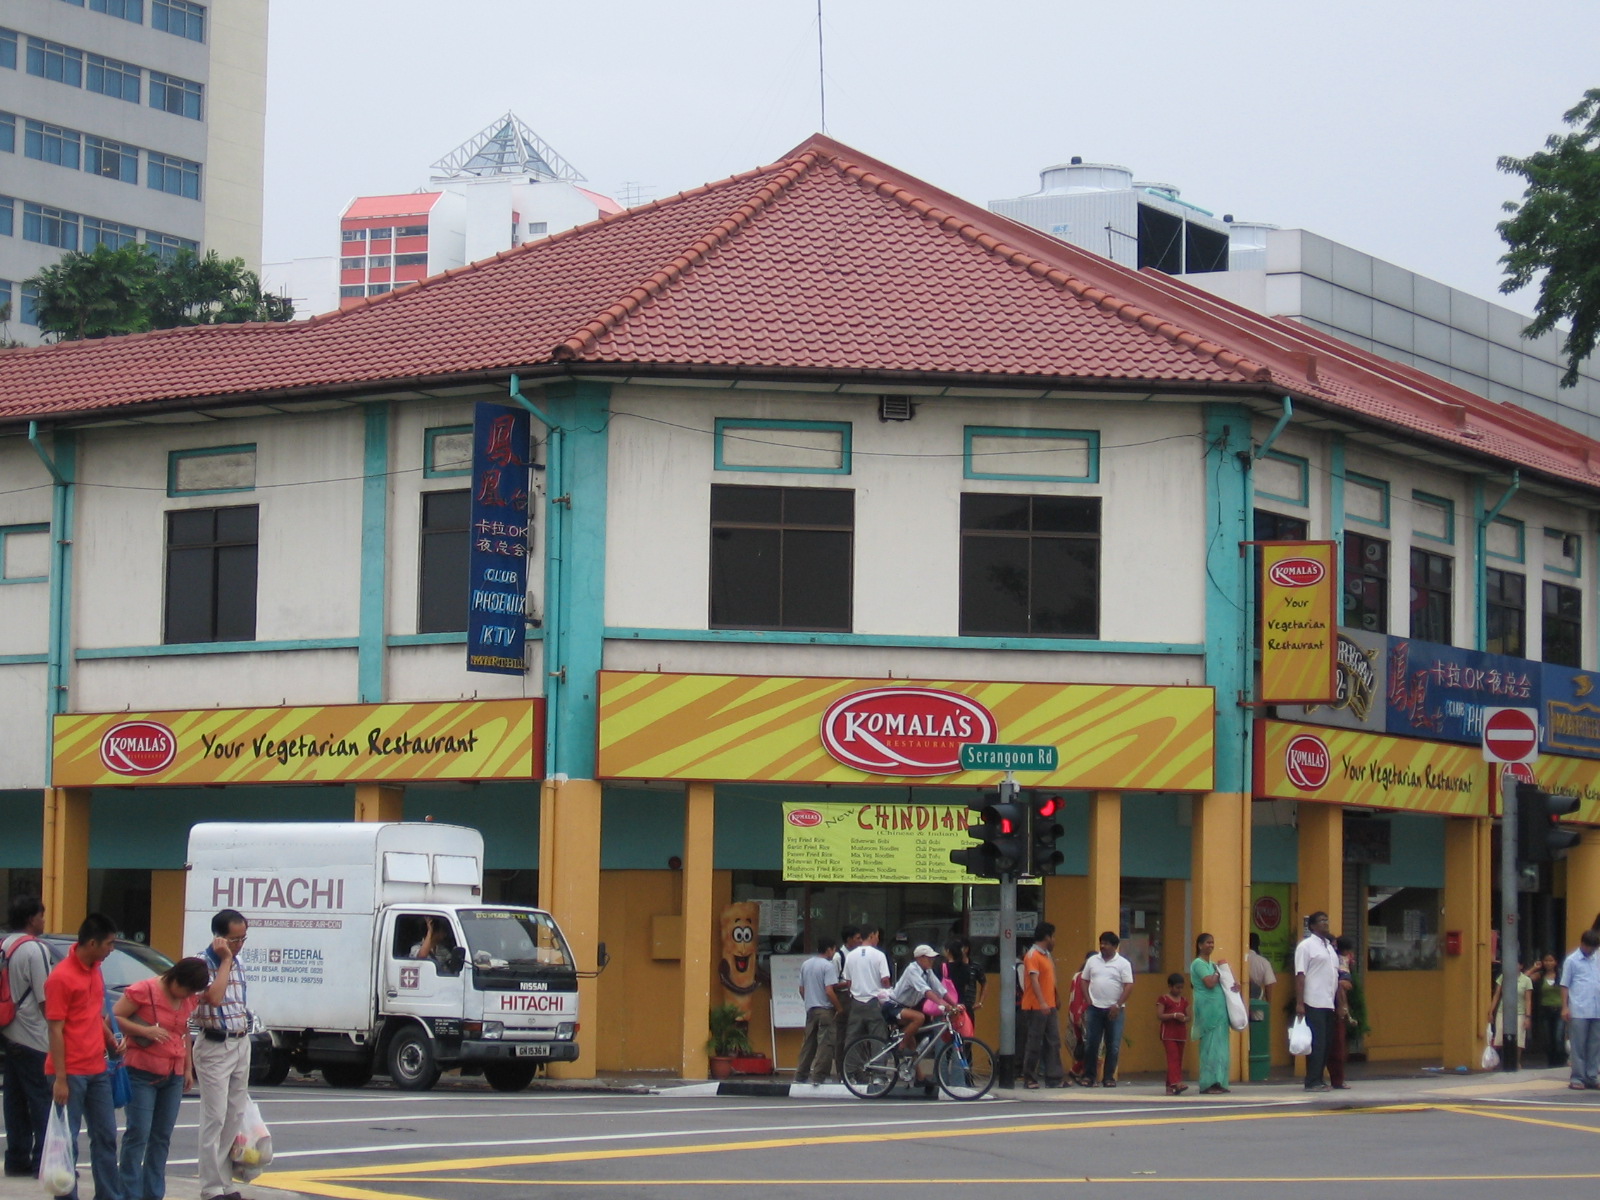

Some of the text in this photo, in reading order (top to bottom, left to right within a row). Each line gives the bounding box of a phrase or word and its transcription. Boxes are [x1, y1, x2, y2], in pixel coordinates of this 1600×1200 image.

[477, 539, 527, 556] 夜总会
[486, 569, 517, 583] CLUB
[1275, 564, 1318, 578] KOMALA'S
[474, 592, 526, 615] PHOENIX
[1285, 597, 1309, 609] Your
[1268, 619, 1326, 633] Vegetarian
[481, 627, 516, 645] KTV
[1268, 639, 1325, 651] Restaurant
[843, 709, 972, 742] KOMALA'S
[109, 733, 167, 757] KOMALA'S
[202, 727, 478, 765] Your Vegetarian Restaurant
[968, 745, 1053, 766] Serangoon Rd
[1290, 749, 1325, 769] KOMALA'S
[1342, 754, 1473, 793] Your Vegetarian Restaurant
[825, 808, 855, 828] New
[857, 804, 969, 831] CHINDIAN
[212, 877, 345, 909] HITACHI
[248, 920, 262, 928] HING
[264, 920, 290, 928] MACHINE
[1004, 928, 1012, 940] 6
[283, 949, 324, 960] FEDERAL
[520, 982, 548, 990] NISSAN
[500, 996, 564, 1012] HITACHI
